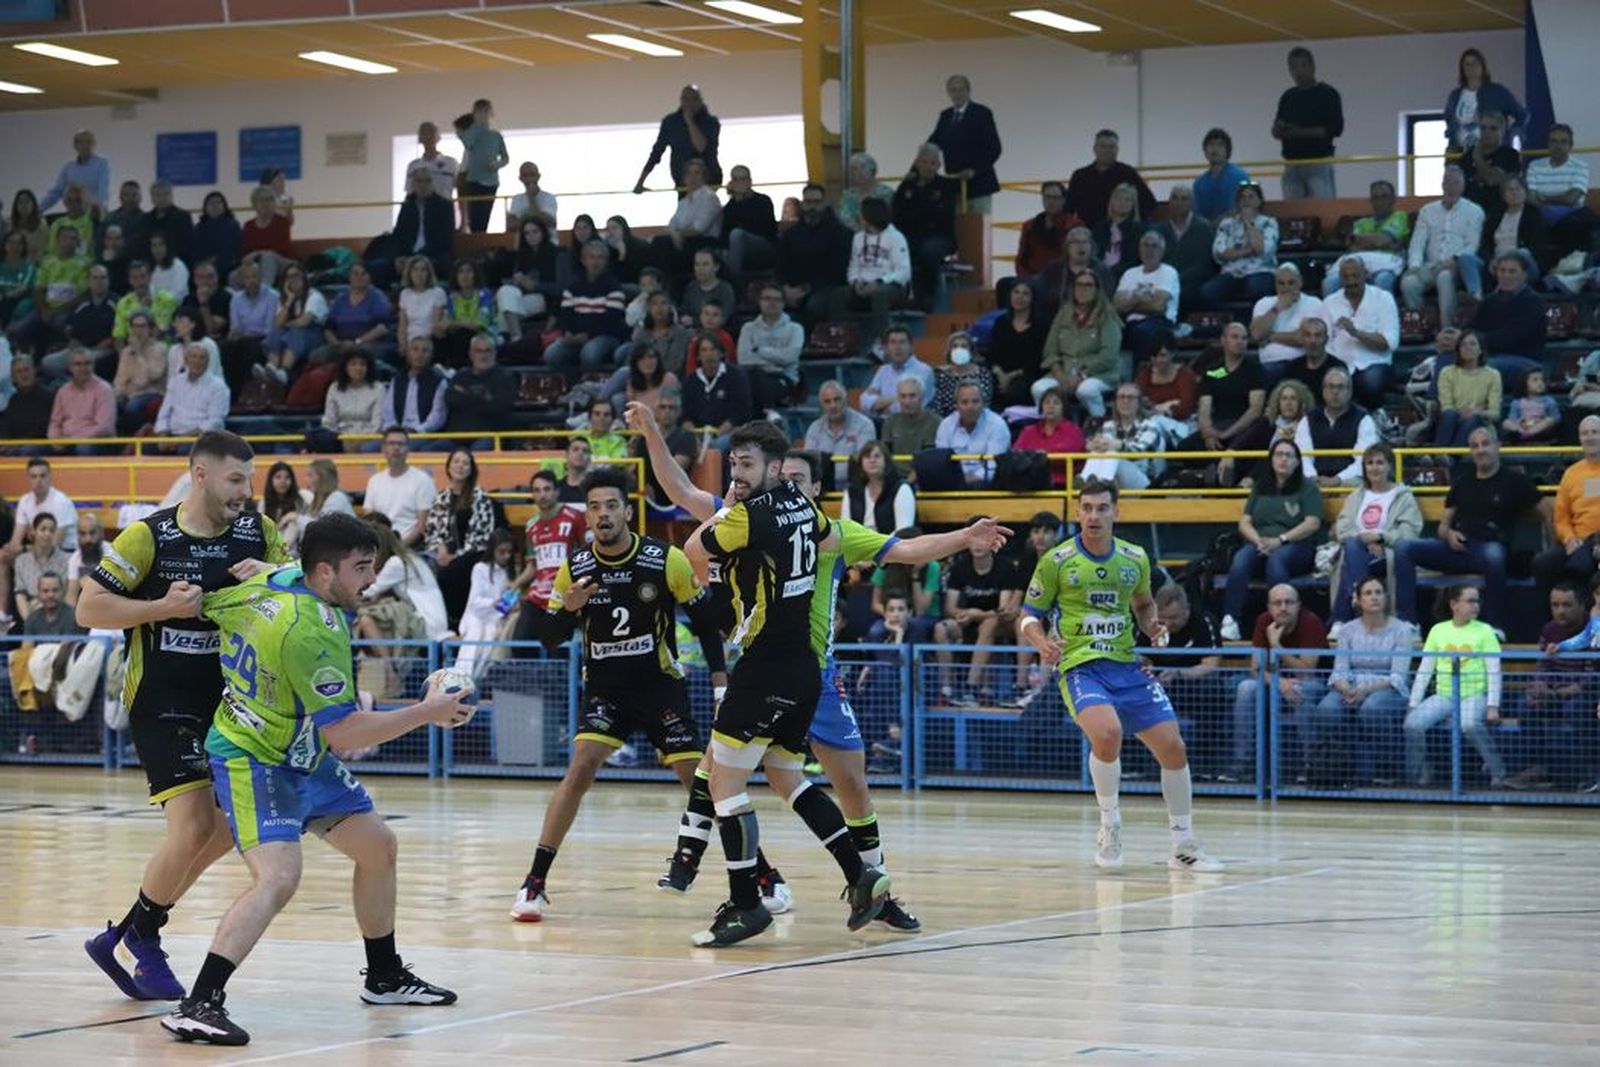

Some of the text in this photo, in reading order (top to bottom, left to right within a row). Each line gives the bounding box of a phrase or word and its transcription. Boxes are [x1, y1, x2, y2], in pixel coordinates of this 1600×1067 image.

[788, 521, 816, 578] 15
[612, 607, 630, 636] 2
[592, 638, 651, 656] Vestas
[219, 632, 258, 700] 29
[840, 702, 857, 726] 4
